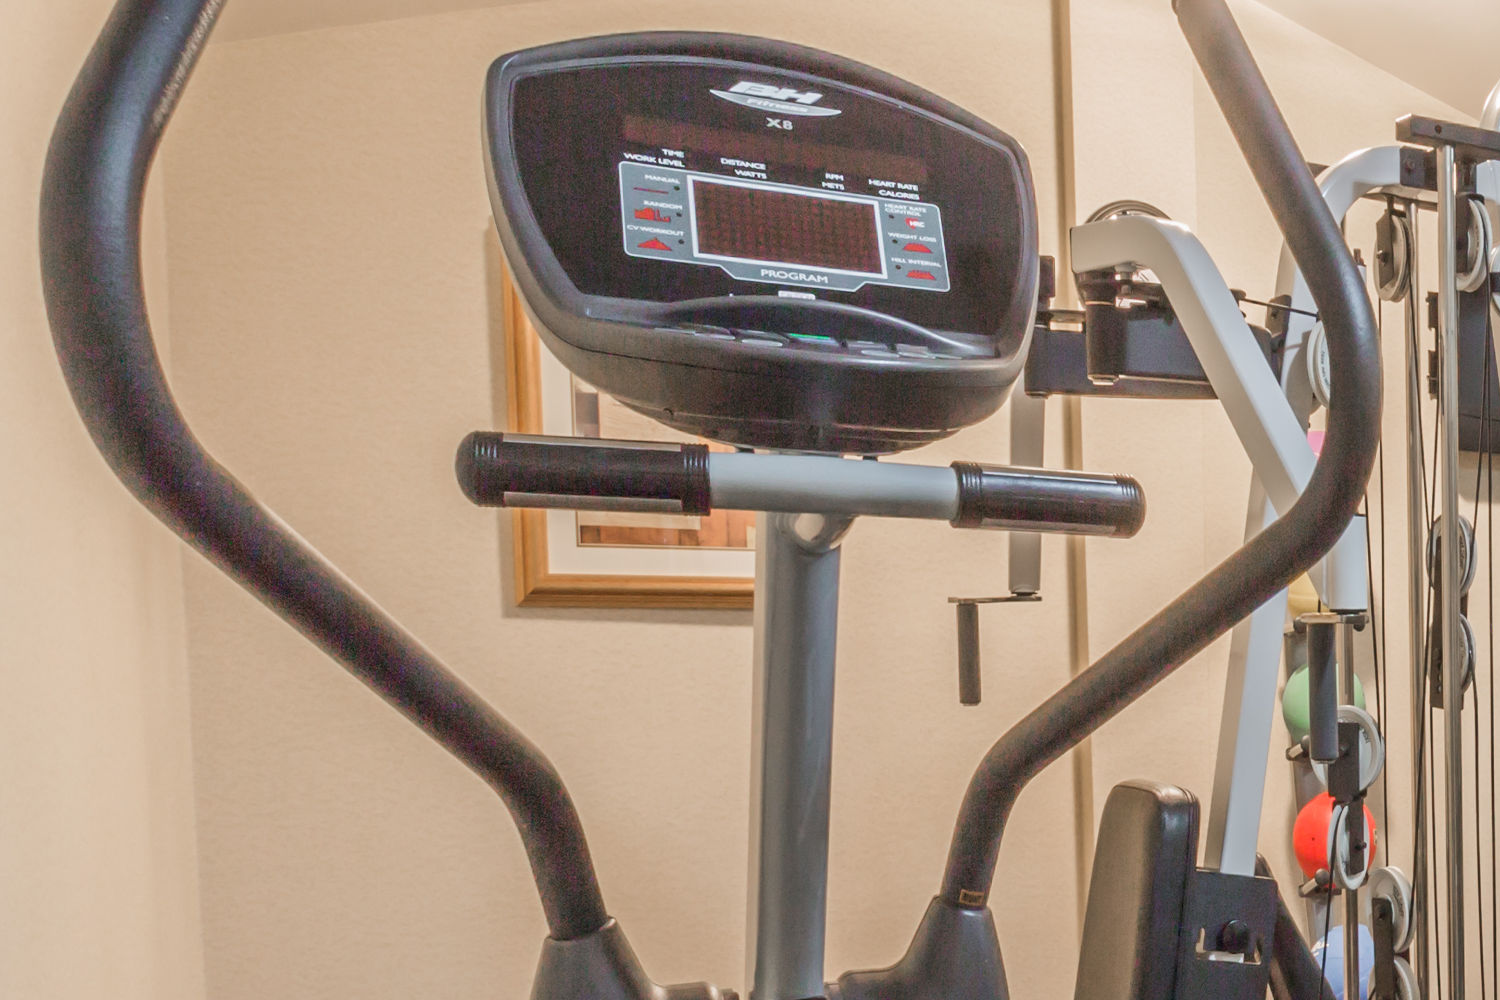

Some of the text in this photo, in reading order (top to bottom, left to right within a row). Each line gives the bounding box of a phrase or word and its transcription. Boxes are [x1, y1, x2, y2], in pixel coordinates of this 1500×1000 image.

[729, 81, 823, 105] BH
[766, 117, 793, 130] X8
[662, 148, 685, 159] TIME
[624, 152, 686, 168] WORK LEVEL
[720, 157, 767, 171] DISTANCE
[644, 173, 681, 185] MANUAL
[734, 168, 768, 180] WATTS
[825, 172, 845, 182] RPM
[821, 181, 845, 191] METS
[868, 178, 919, 192] HEART RATE
[878, 189, 920, 201] CALORIES
[643, 199, 683, 211] RANDOM
[888, 231, 918, 241] WEIGHT
[760, 268, 828, 284] PROGRAM
